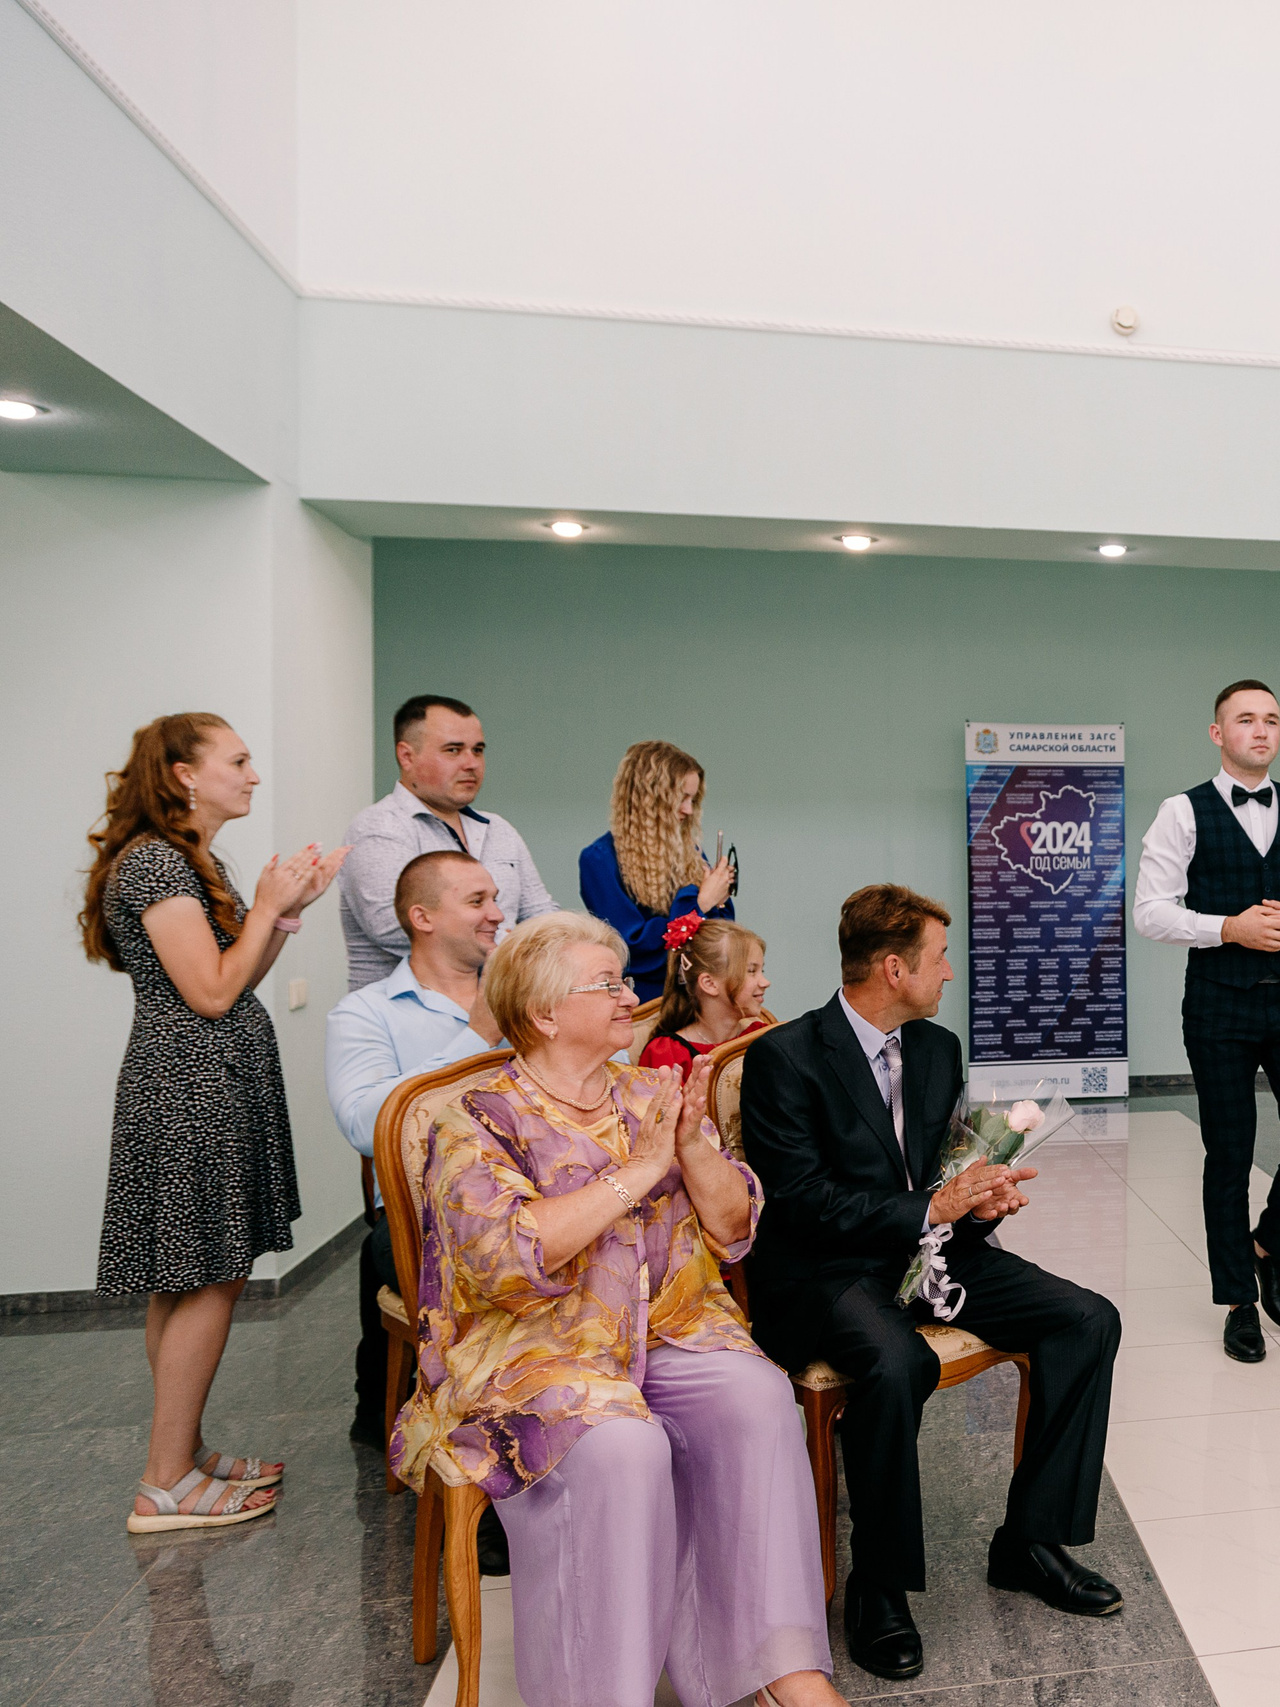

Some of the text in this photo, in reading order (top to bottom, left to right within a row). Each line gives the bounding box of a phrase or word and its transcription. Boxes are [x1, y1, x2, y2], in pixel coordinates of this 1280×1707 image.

[1009, 732, 1116, 741] УПРАВЛЕНИЕ ЗАГС
[1009, 743, 1116, 753] САМАРСКОЙ ОБЛАСТИ
[1030, 821, 1093, 855] 2024
